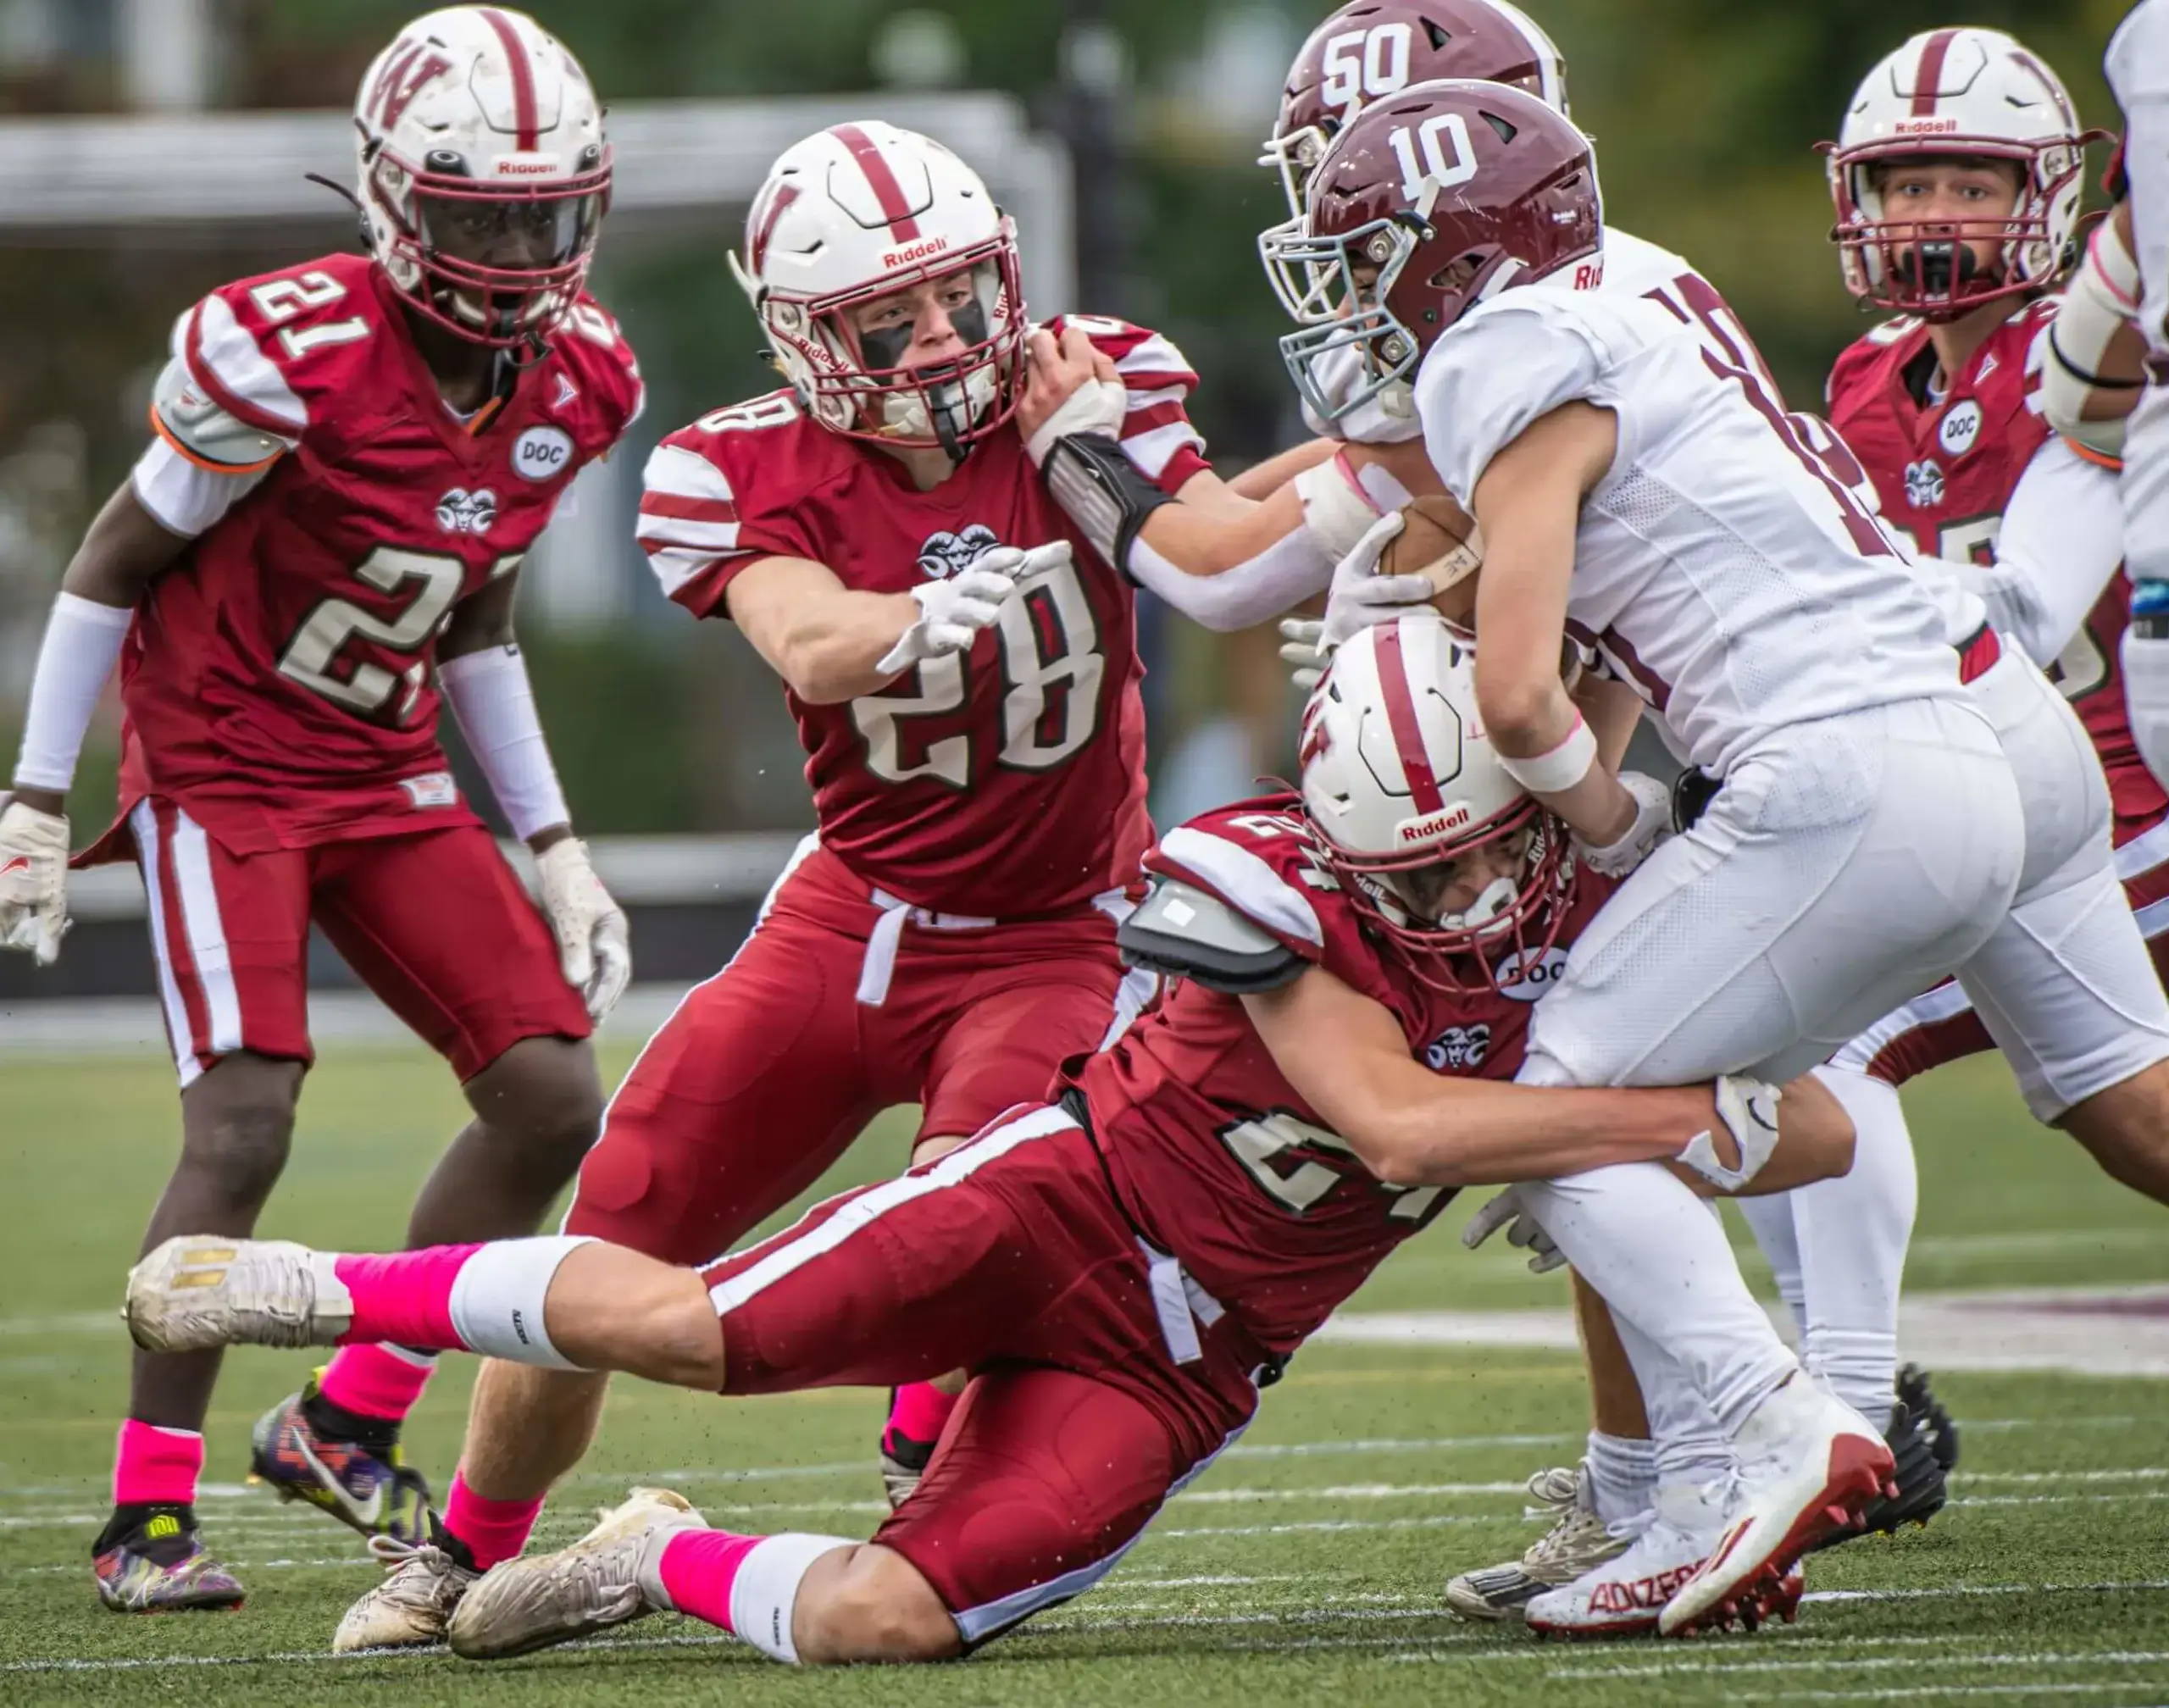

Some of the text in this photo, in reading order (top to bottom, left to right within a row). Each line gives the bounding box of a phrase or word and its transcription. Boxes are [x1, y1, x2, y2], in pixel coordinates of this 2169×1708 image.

[1322, 23, 1412, 107] 50
[1389, 114, 1478, 202] 10
[884, 238, 946, 268] Riddell
[248, 272, 373, 358] 21
[523, 442, 563, 463] DOC
[1946, 415, 1976, 439] DOC
[850, 557, 1104, 787] 28
[1402, 808, 1470, 841] Riddell
[1587, 1557, 1710, 1615] ADIZER
